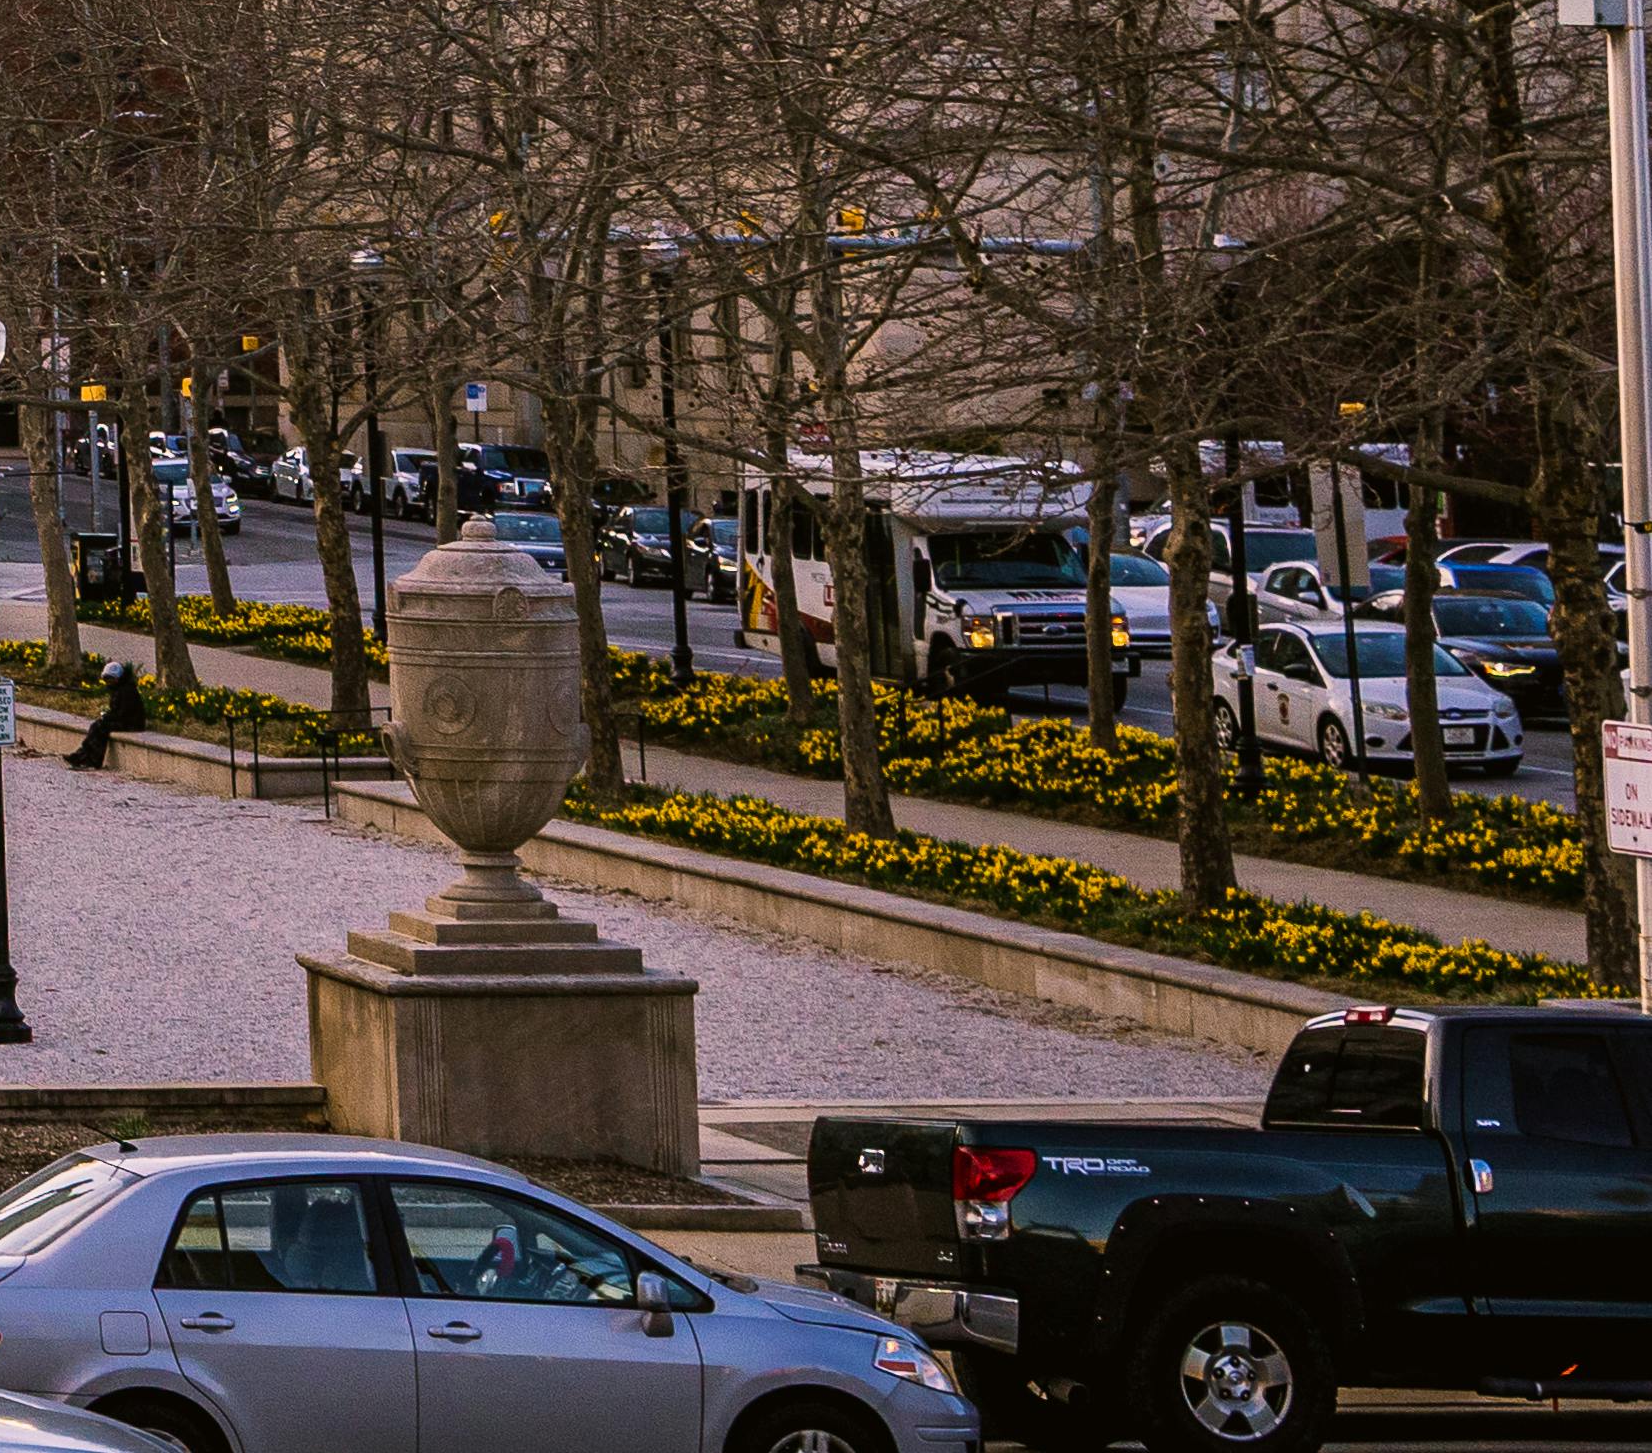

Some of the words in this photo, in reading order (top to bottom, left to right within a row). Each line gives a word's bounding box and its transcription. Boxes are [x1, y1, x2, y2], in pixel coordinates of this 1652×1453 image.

[1626, 782, 1638, 801] ON
[1611, 807, 1652, 830] SIDEWAL
[1042, 1156, 1106, 1175] TRD
[1107, 1165, 1152, 1173] ROAD
